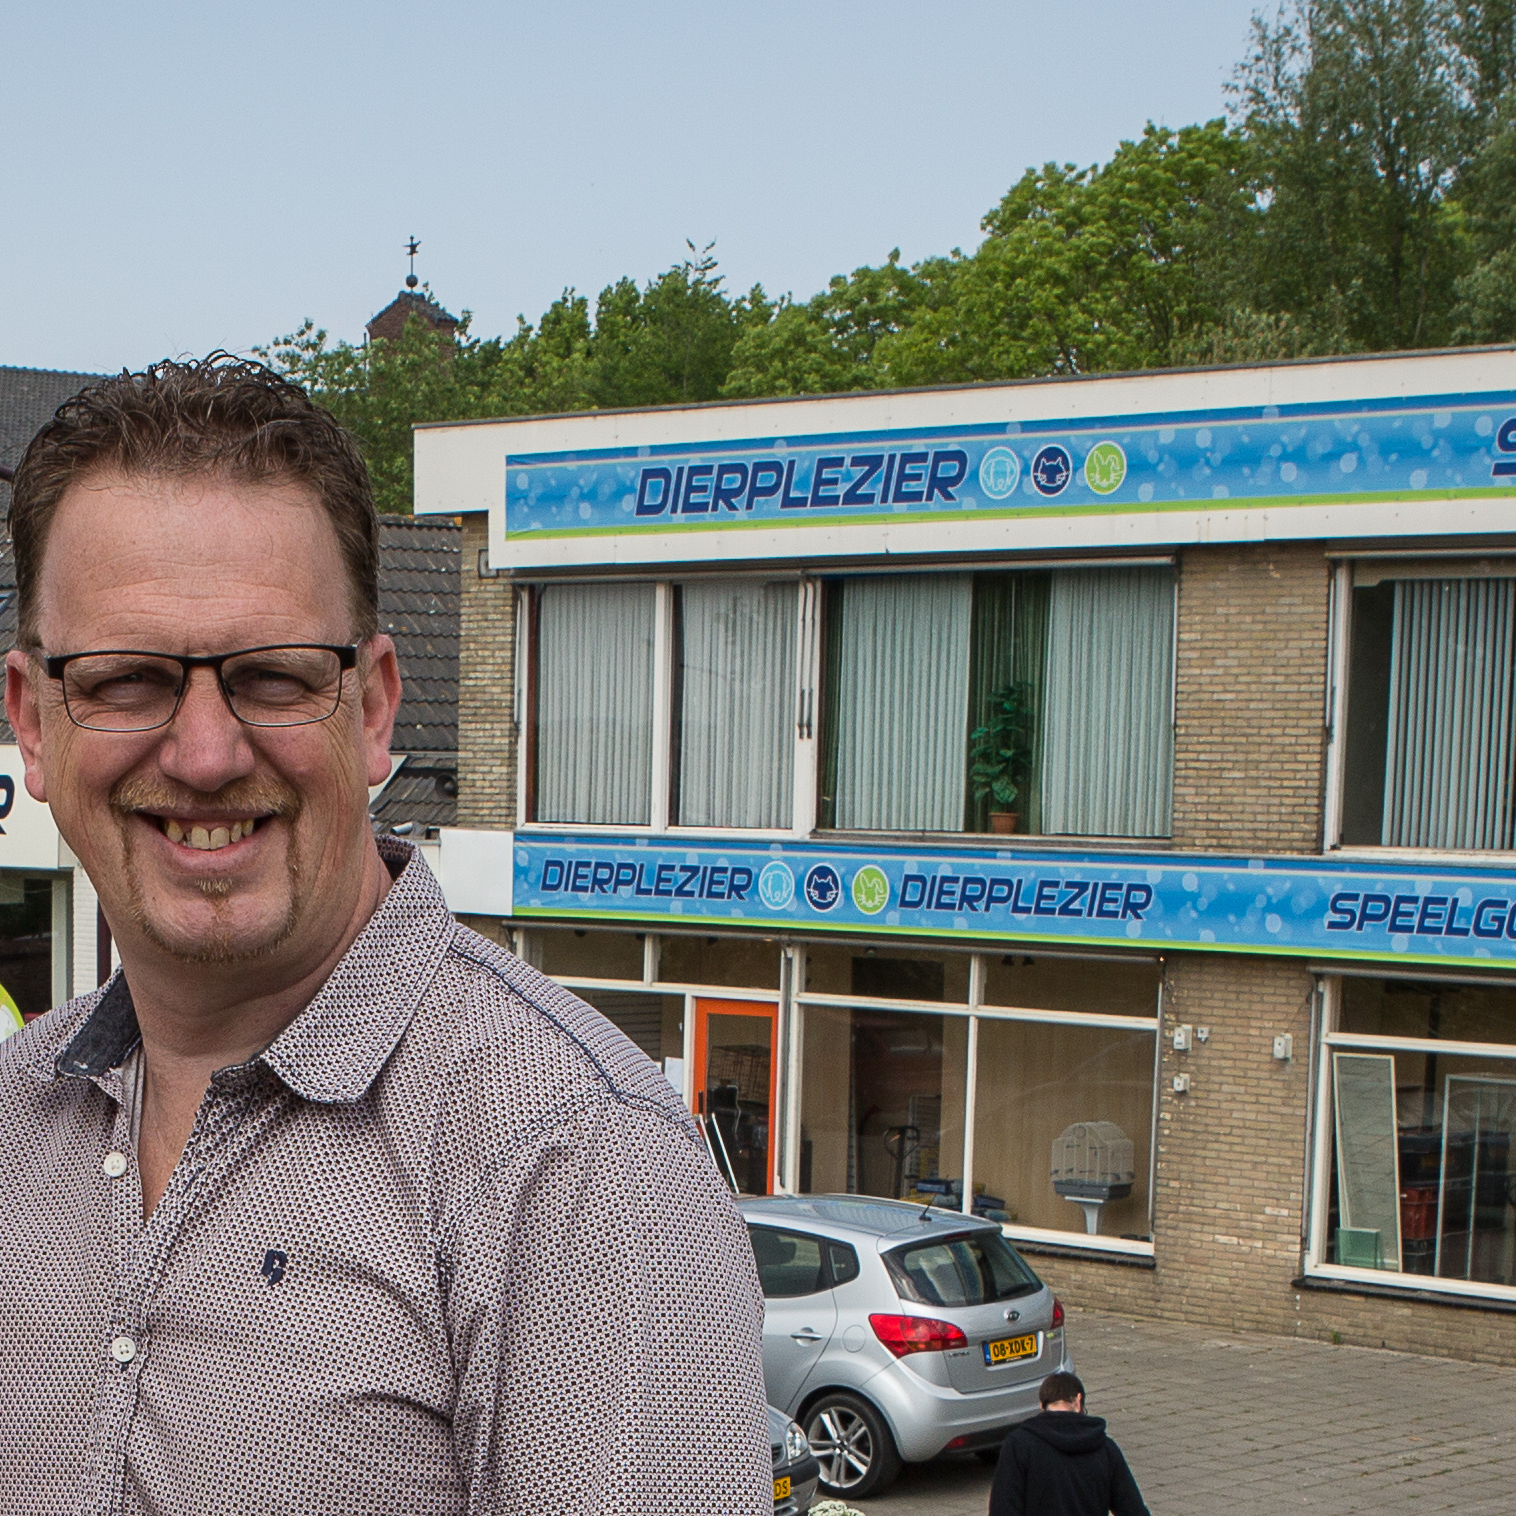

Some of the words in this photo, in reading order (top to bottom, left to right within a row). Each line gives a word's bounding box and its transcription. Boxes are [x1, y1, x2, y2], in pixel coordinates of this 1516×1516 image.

[636, 450, 967, 516] DIERPLEZIER
[541, 860, 752, 900] DIERPLEZIER
[899, 874, 1152, 919] DIERPLEZIER
[992, 1335, 1034, 1358] 08-XDK-7
